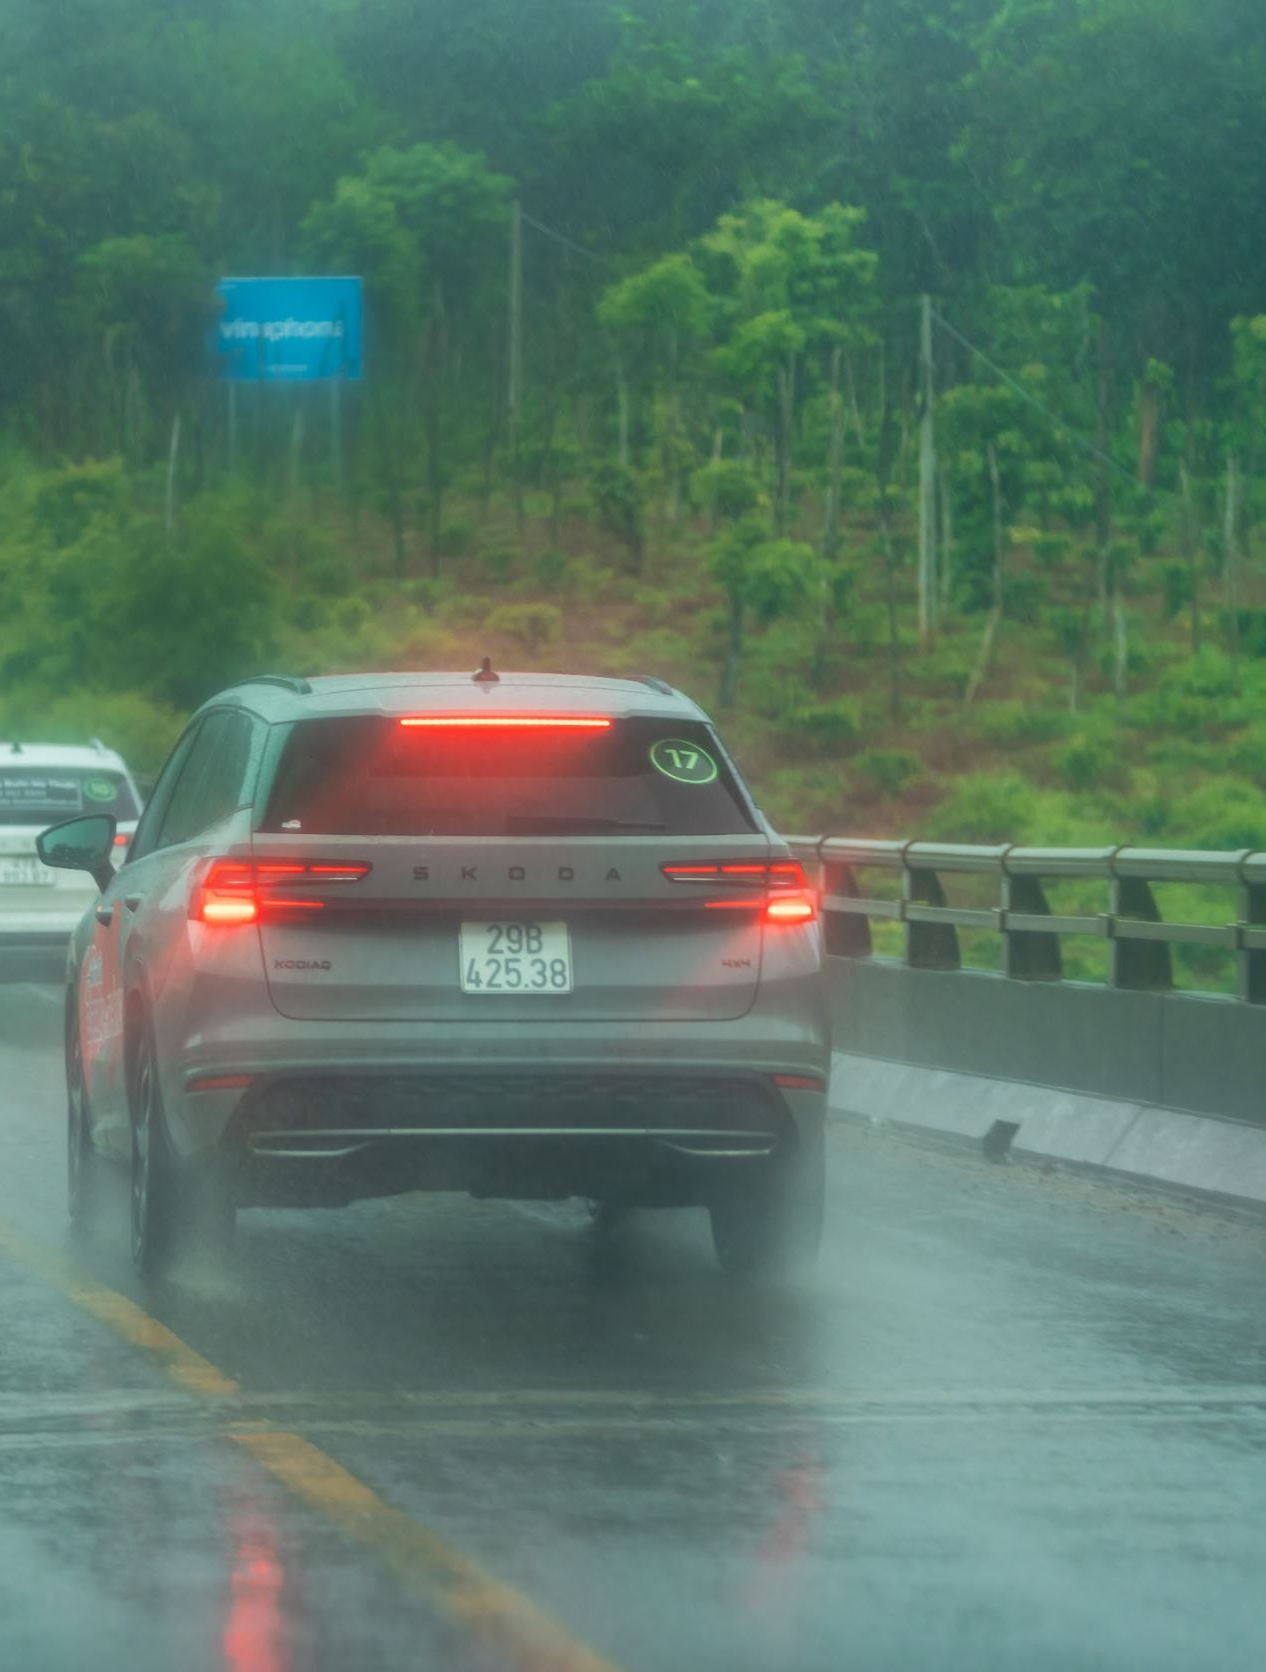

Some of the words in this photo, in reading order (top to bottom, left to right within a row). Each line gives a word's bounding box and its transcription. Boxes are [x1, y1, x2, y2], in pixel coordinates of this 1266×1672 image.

[664, 748, 699, 770] 17
[412, 866, 623, 882] SKODA
[485, 923, 543, 955] 29B
[274, 959, 333, 972] KODIAQ
[465, 957, 568, 989] 425.38
